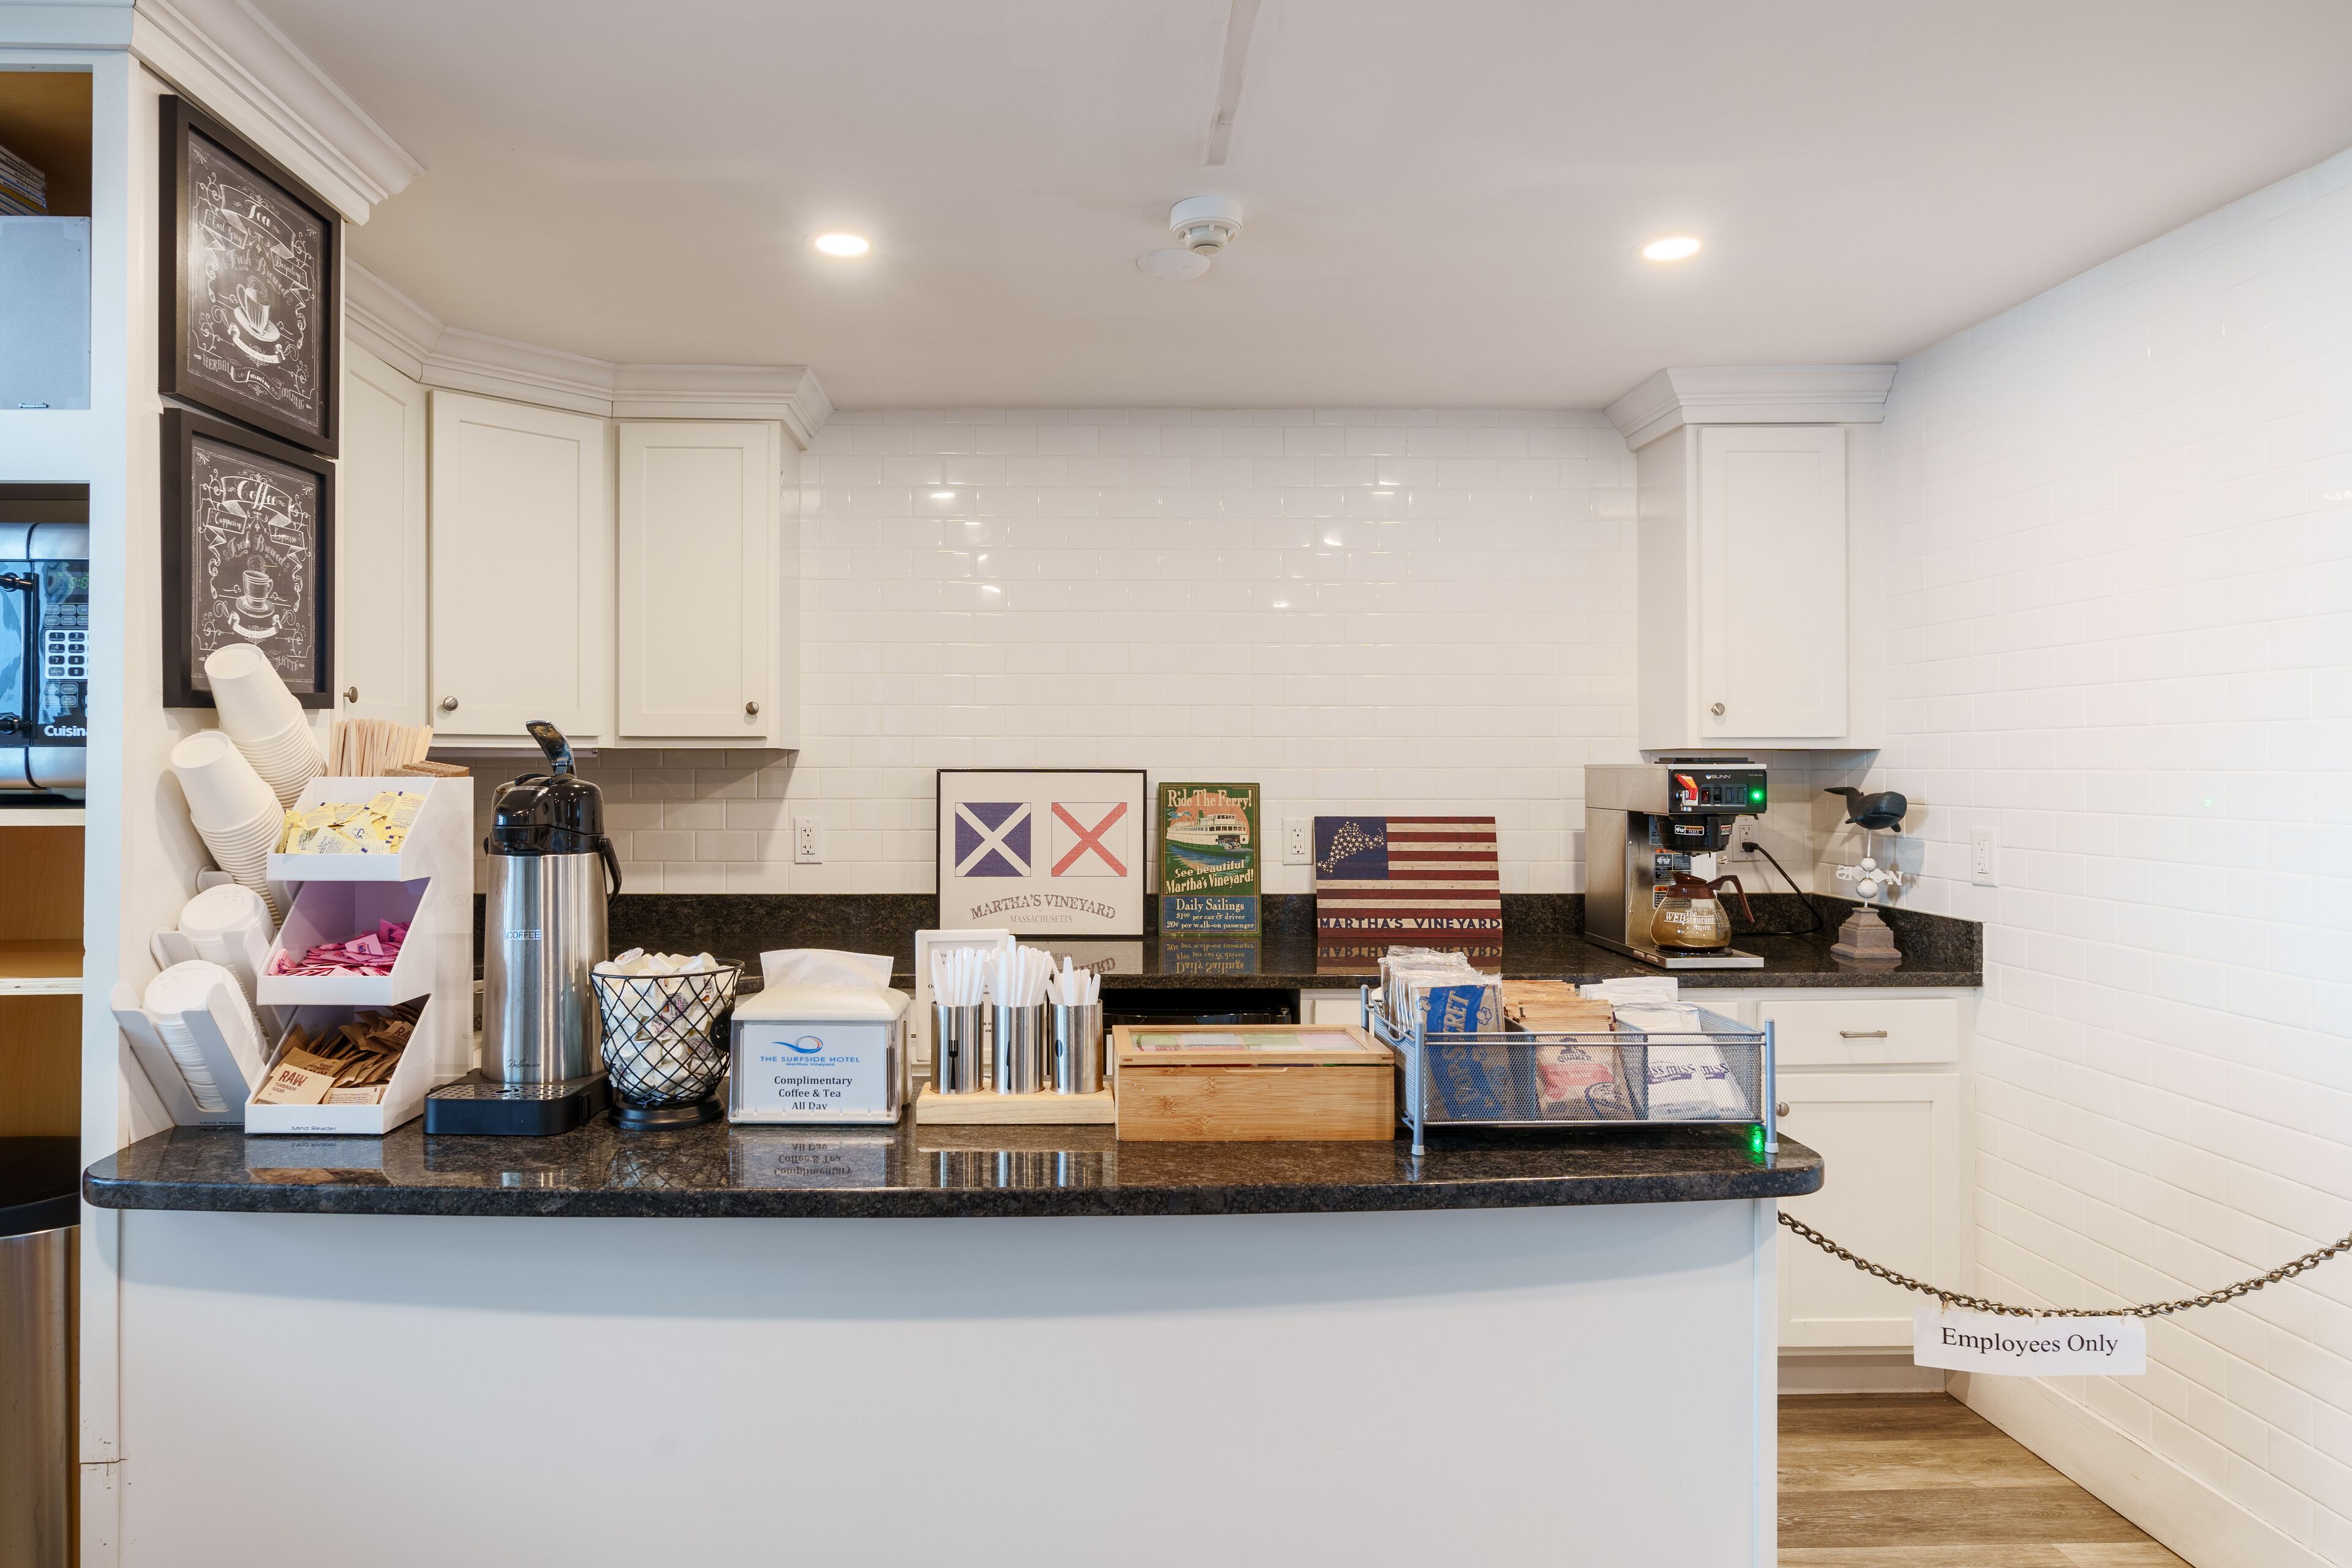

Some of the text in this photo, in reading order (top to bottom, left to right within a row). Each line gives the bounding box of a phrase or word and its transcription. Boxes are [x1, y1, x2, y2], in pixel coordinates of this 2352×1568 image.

[245, 200, 271, 227] Tea
[212, 216, 243, 243] Earl Grey
[226, 249, 290, 298] Fresh Brewed
[275, 256, 303, 283] Darjeeling
[203, 353, 231, 374] HERBAL
[245, 370, 271, 390] Jasmine
[281, 387, 305, 410] OOLONG
[235, 479, 277, 510] Coffee
[274, 527, 297, 543] Espresso
[227, 532, 287, 567] Fresh Brewed
[277, 656, 299, 671] LATTE
[44, 725, 87, 737] Cuisin
[1167, 789, 1252, 810] Ride The Ferry!
[1175, 859, 1245, 878] See beautiful
[1166, 869, 1254, 894] Martha's Vineyard!
[970, 894, 1116, 920] MARTHA'S VINEYARD
[1176, 898, 1245, 912] Daily Sailings
[1320, 918, 1501, 930] MARTHA'S VINEYARD
[394, 1026, 412, 1040] RA
[275, 1082, 297, 1092] TURBINADO
[278, 1070, 308, 1087] RAW
[774, 1076, 853, 1087] Complimentary
[778, 1088, 841, 1098] Coffee & Tea
[791, 1101, 805, 1110] All
[1940, 1327, 2119, 1357] Employees Only
